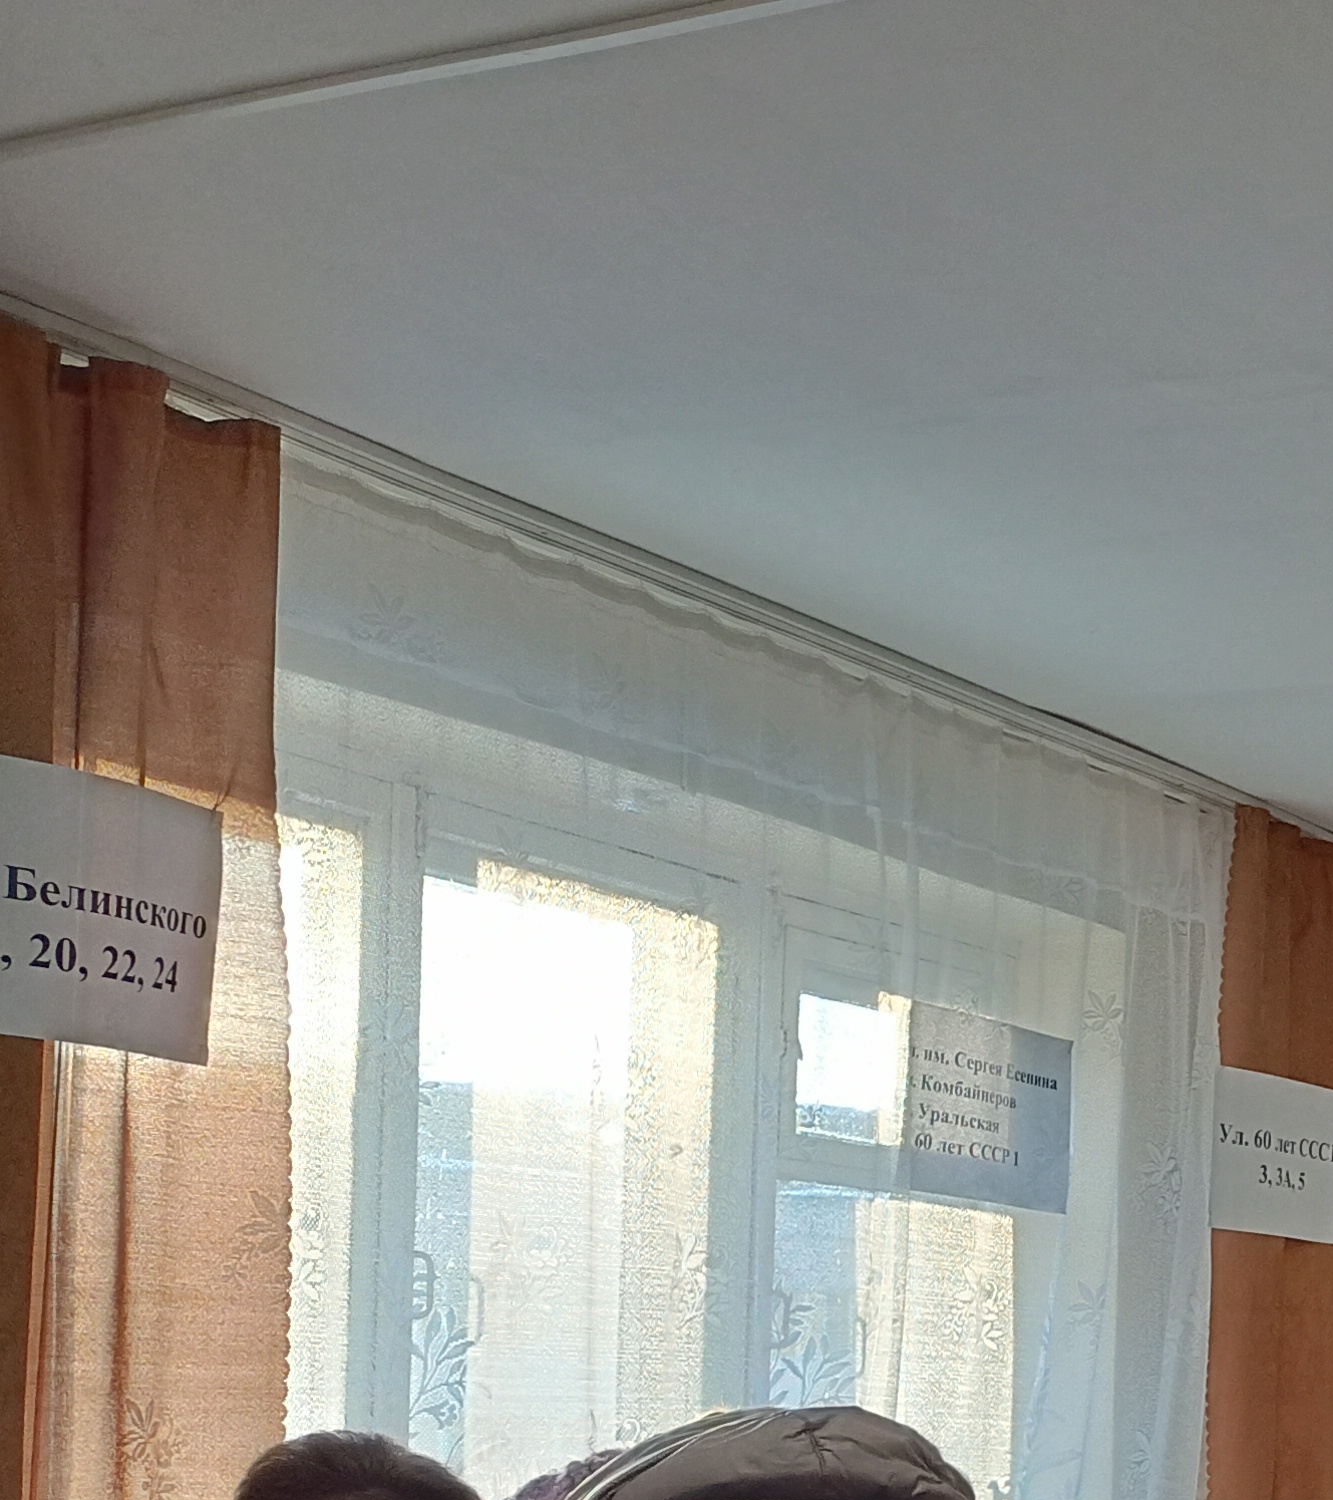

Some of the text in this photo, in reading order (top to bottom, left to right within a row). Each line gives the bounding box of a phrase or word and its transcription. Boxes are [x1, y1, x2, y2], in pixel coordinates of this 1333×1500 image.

[2, 864, 207, 939] Белинского
[29, 933, 88, 982] 20,
[954, 1050, 1003, 1077] Сергея
[1006, 1062, 1058, 1091] Есенина
[921, 1074, 1017, 1110] Комбайнеров
[919, 1102, 1000, 1134] Уральская
[914, 1132, 932, 1151] 60
[936, 1140, 966, 1156] лет
[969, 1141, 1010, 1164] СССР
[1220, 1123, 1249, 1147] Ул.
[1254, 1129, 1272, 1150] 60
[1274, 1138, 1297, 1155] лет
